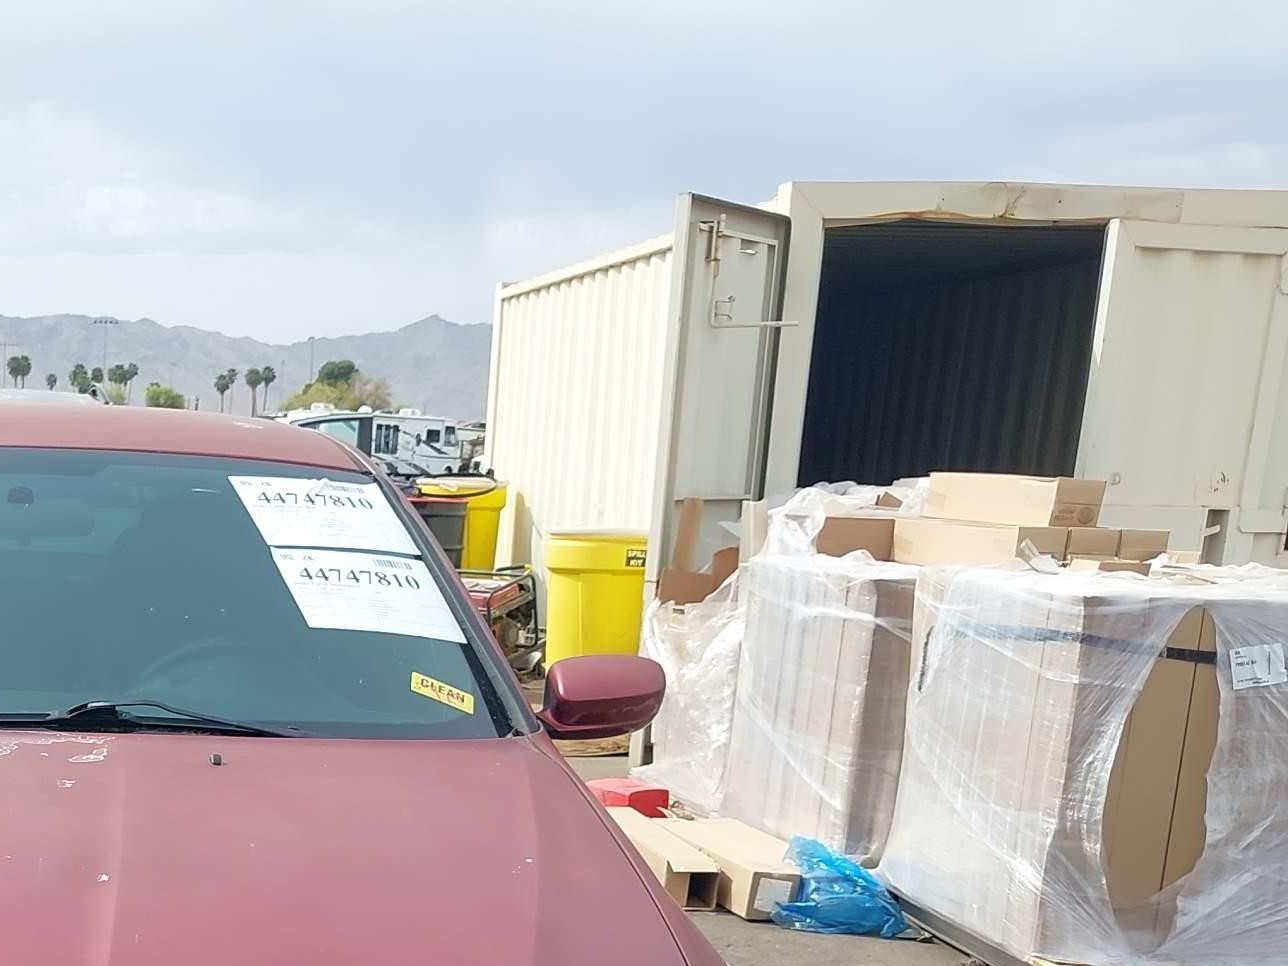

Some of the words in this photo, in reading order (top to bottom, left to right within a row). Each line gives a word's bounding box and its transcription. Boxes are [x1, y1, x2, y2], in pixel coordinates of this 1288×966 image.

[258, 491, 374, 510] 44747810
[299, 567, 421, 590] 44747810
[420, 678, 465, 704] CLEAN
